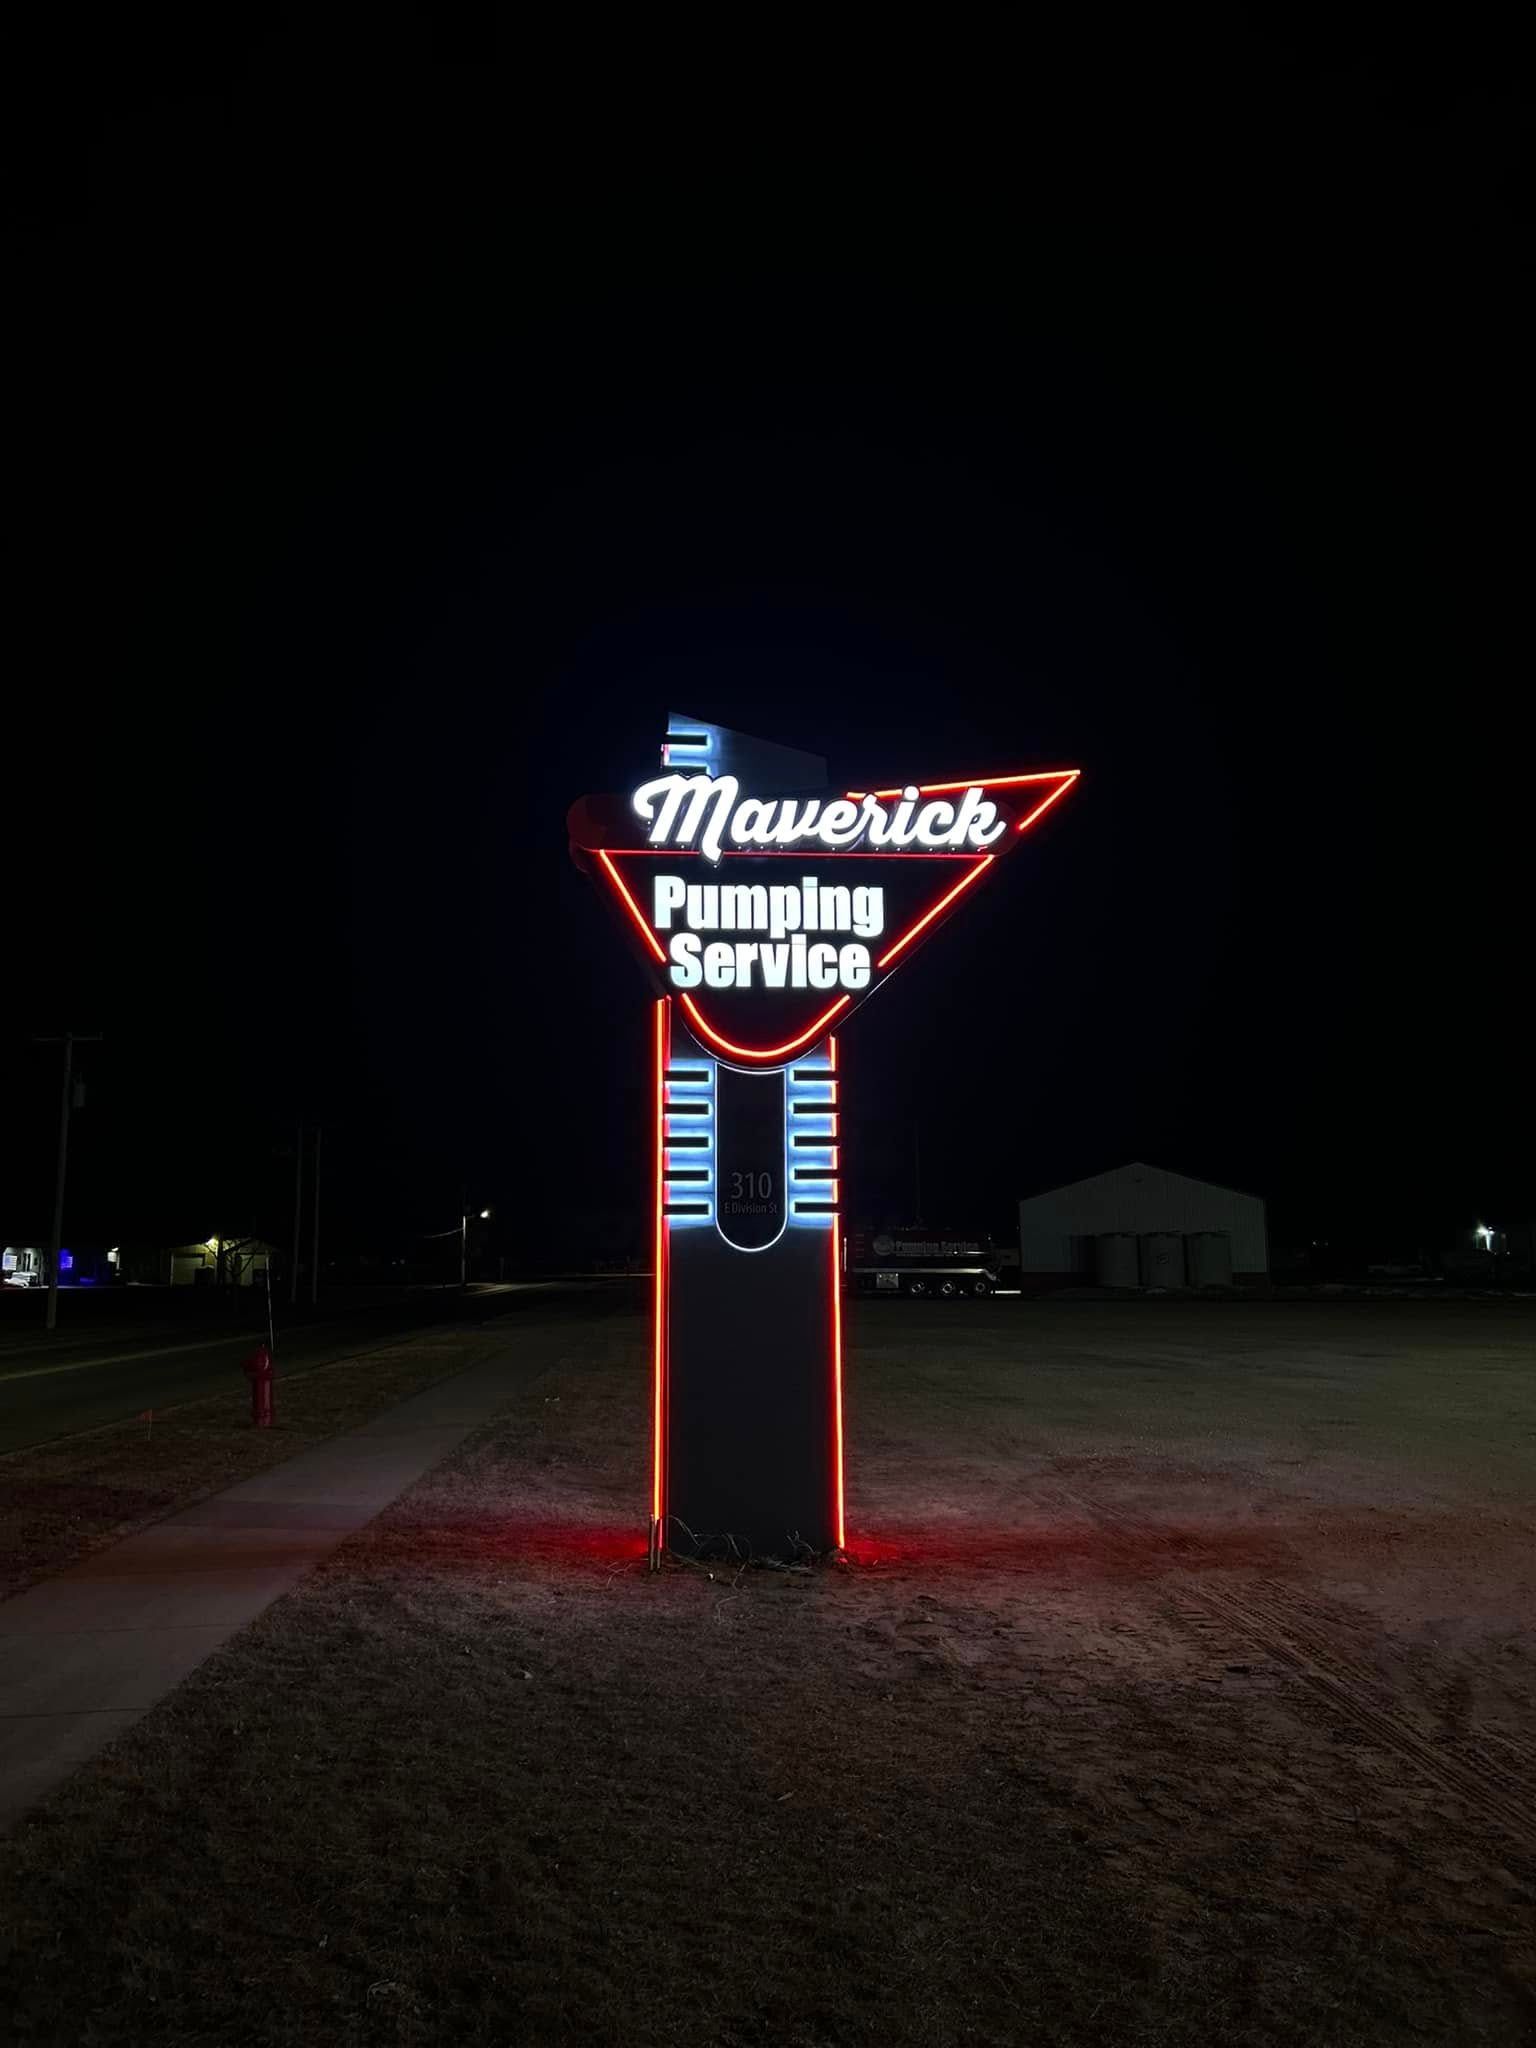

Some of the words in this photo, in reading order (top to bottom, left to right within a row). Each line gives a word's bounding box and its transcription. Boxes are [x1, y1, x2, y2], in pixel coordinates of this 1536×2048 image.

[632, 773, 1006, 863] Maverick
[653, 875, 885, 938] Pumping
[669, 933, 872, 989] Service
[723, 1201, 731, 1214] E
[731, 1201, 767, 1215] Division
[730, 1171, 773, 1200] 310
